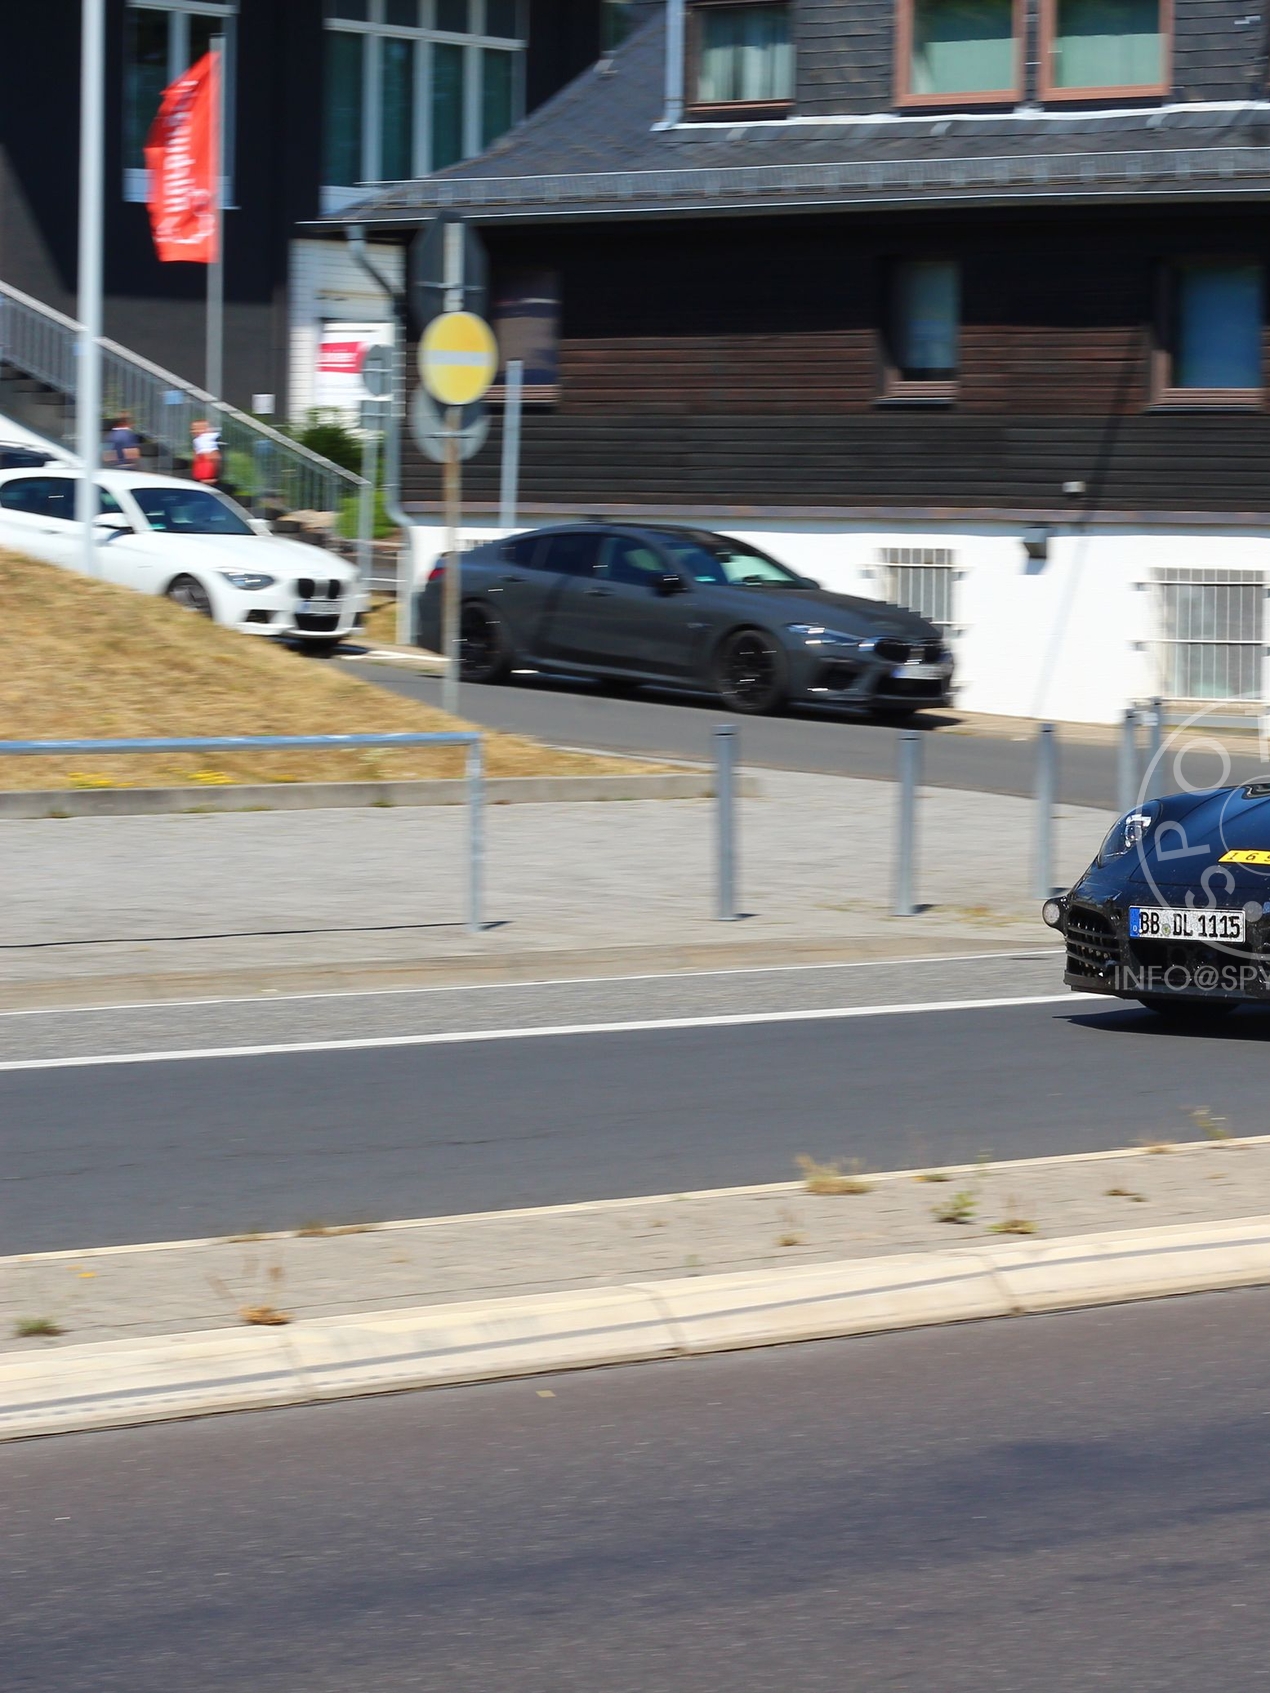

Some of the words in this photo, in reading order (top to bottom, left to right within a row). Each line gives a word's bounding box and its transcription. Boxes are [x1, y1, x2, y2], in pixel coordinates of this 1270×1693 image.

[1140, 912, 1160, 935] BB
[1173, 913, 1193, 936] DL
[1198, 915, 1240, 938] 1115
